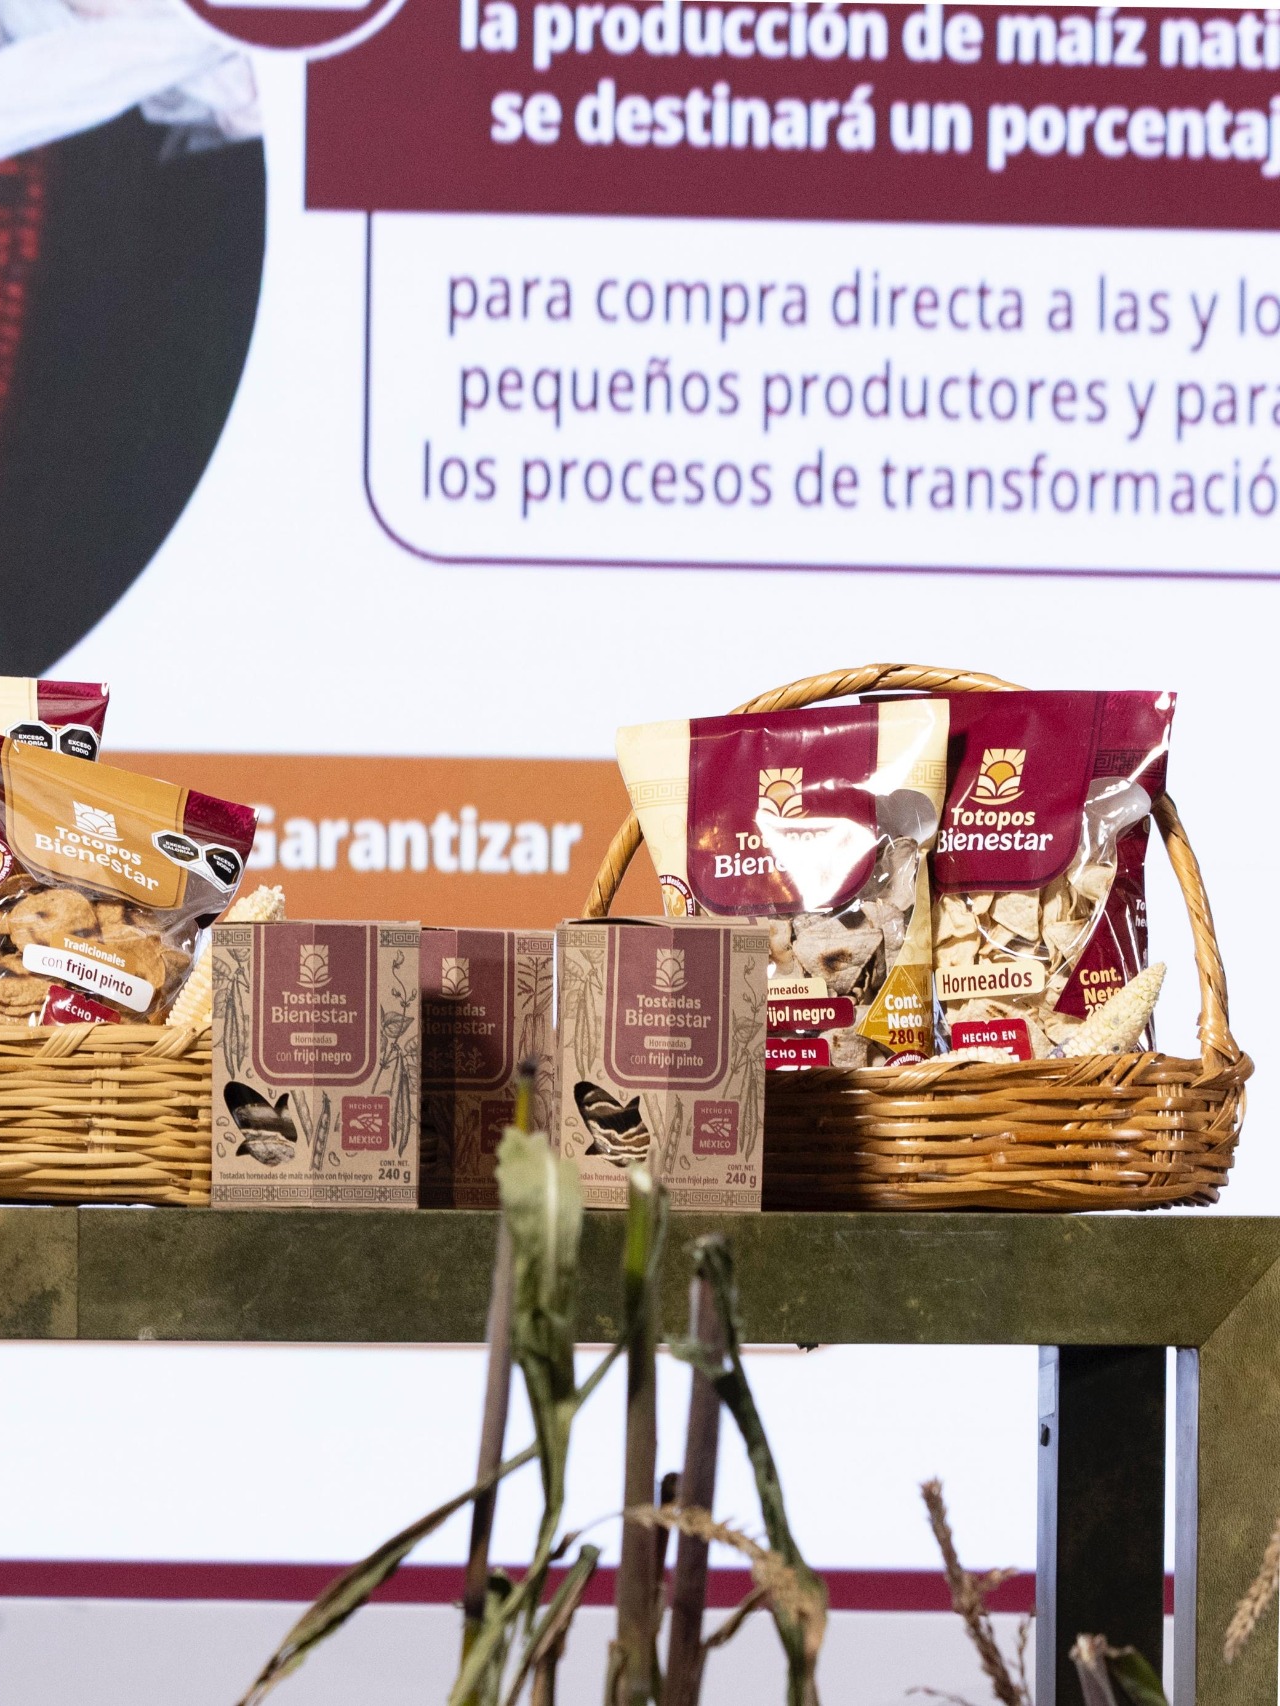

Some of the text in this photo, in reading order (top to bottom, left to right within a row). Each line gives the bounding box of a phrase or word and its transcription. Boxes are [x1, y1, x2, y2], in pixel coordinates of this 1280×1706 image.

[460, 0, 519, 52] la
[532, 0, 889, 72] producción
[901, 4, 984, 64] de
[996, 7, 1148, 68] maíz
[490, 90, 562, 145] se
[575, 78, 877, 152] destinará
[889, 100, 973, 155] un
[448, 274, 572, 338] para
[596, 277, 807, 343] compra
[832, 268, 1022, 332] directa
[1047, 288, 1073, 333] a
[1099, 273, 1170, 335] las
[1190, 292, 1218, 353] y
[460, 355, 740, 430] pequeños
[764, 358, 1108, 434] productores
[1128, 380, 1154, 442] y
[424, 440, 1277, 520] los procesos de transformació
[68, 739, 91, 750] EXCESO
[72, 746, 89, 756] SODIO
[951, 807, 1036, 831] Totopos
[55, 826, 141, 866] Totopos
[937, 827, 1053, 853] Bienestar
[34, 833, 159, 891] Bienestar
[63, 937, 126, 968] Tradicionales
[42, 956, 133, 996] con frijol pinto
[942, 967, 1033, 994] Horneados
[1079, 966, 1122, 986] Cont.
[282, 991, 347, 1004] Tostadas
[767, 984, 809, 995] rneados
[637, 994, 701, 1009] Tostadas
[884, 993, 922, 1010] Cont.
[60, 1001, 91, 1021] ECHO
[271, 1006, 357, 1023] Bienestar
[625, 1009, 711, 1028] Bienestar
[767, 1006, 835, 1026] ijol negro
[887, 1012, 923, 1029] Neto
[294, 1035, 332, 1044] Horneadas
[648, 1039, 687, 1048] Horneadas
[888, 1029, 925, 1047] 280 g
[962, 1030, 1017, 1043] HECHO EN
[276, 1049, 352, 1065] con frijol negro
[630, 1052, 704, 1069] con frijol pinto
[765, 1049, 817, 1058] ECHO EN
[378, 1168, 399, 1181] 240
[403, 1170, 411, 1183] g
[726, 1172, 756, 1188] 240 g
